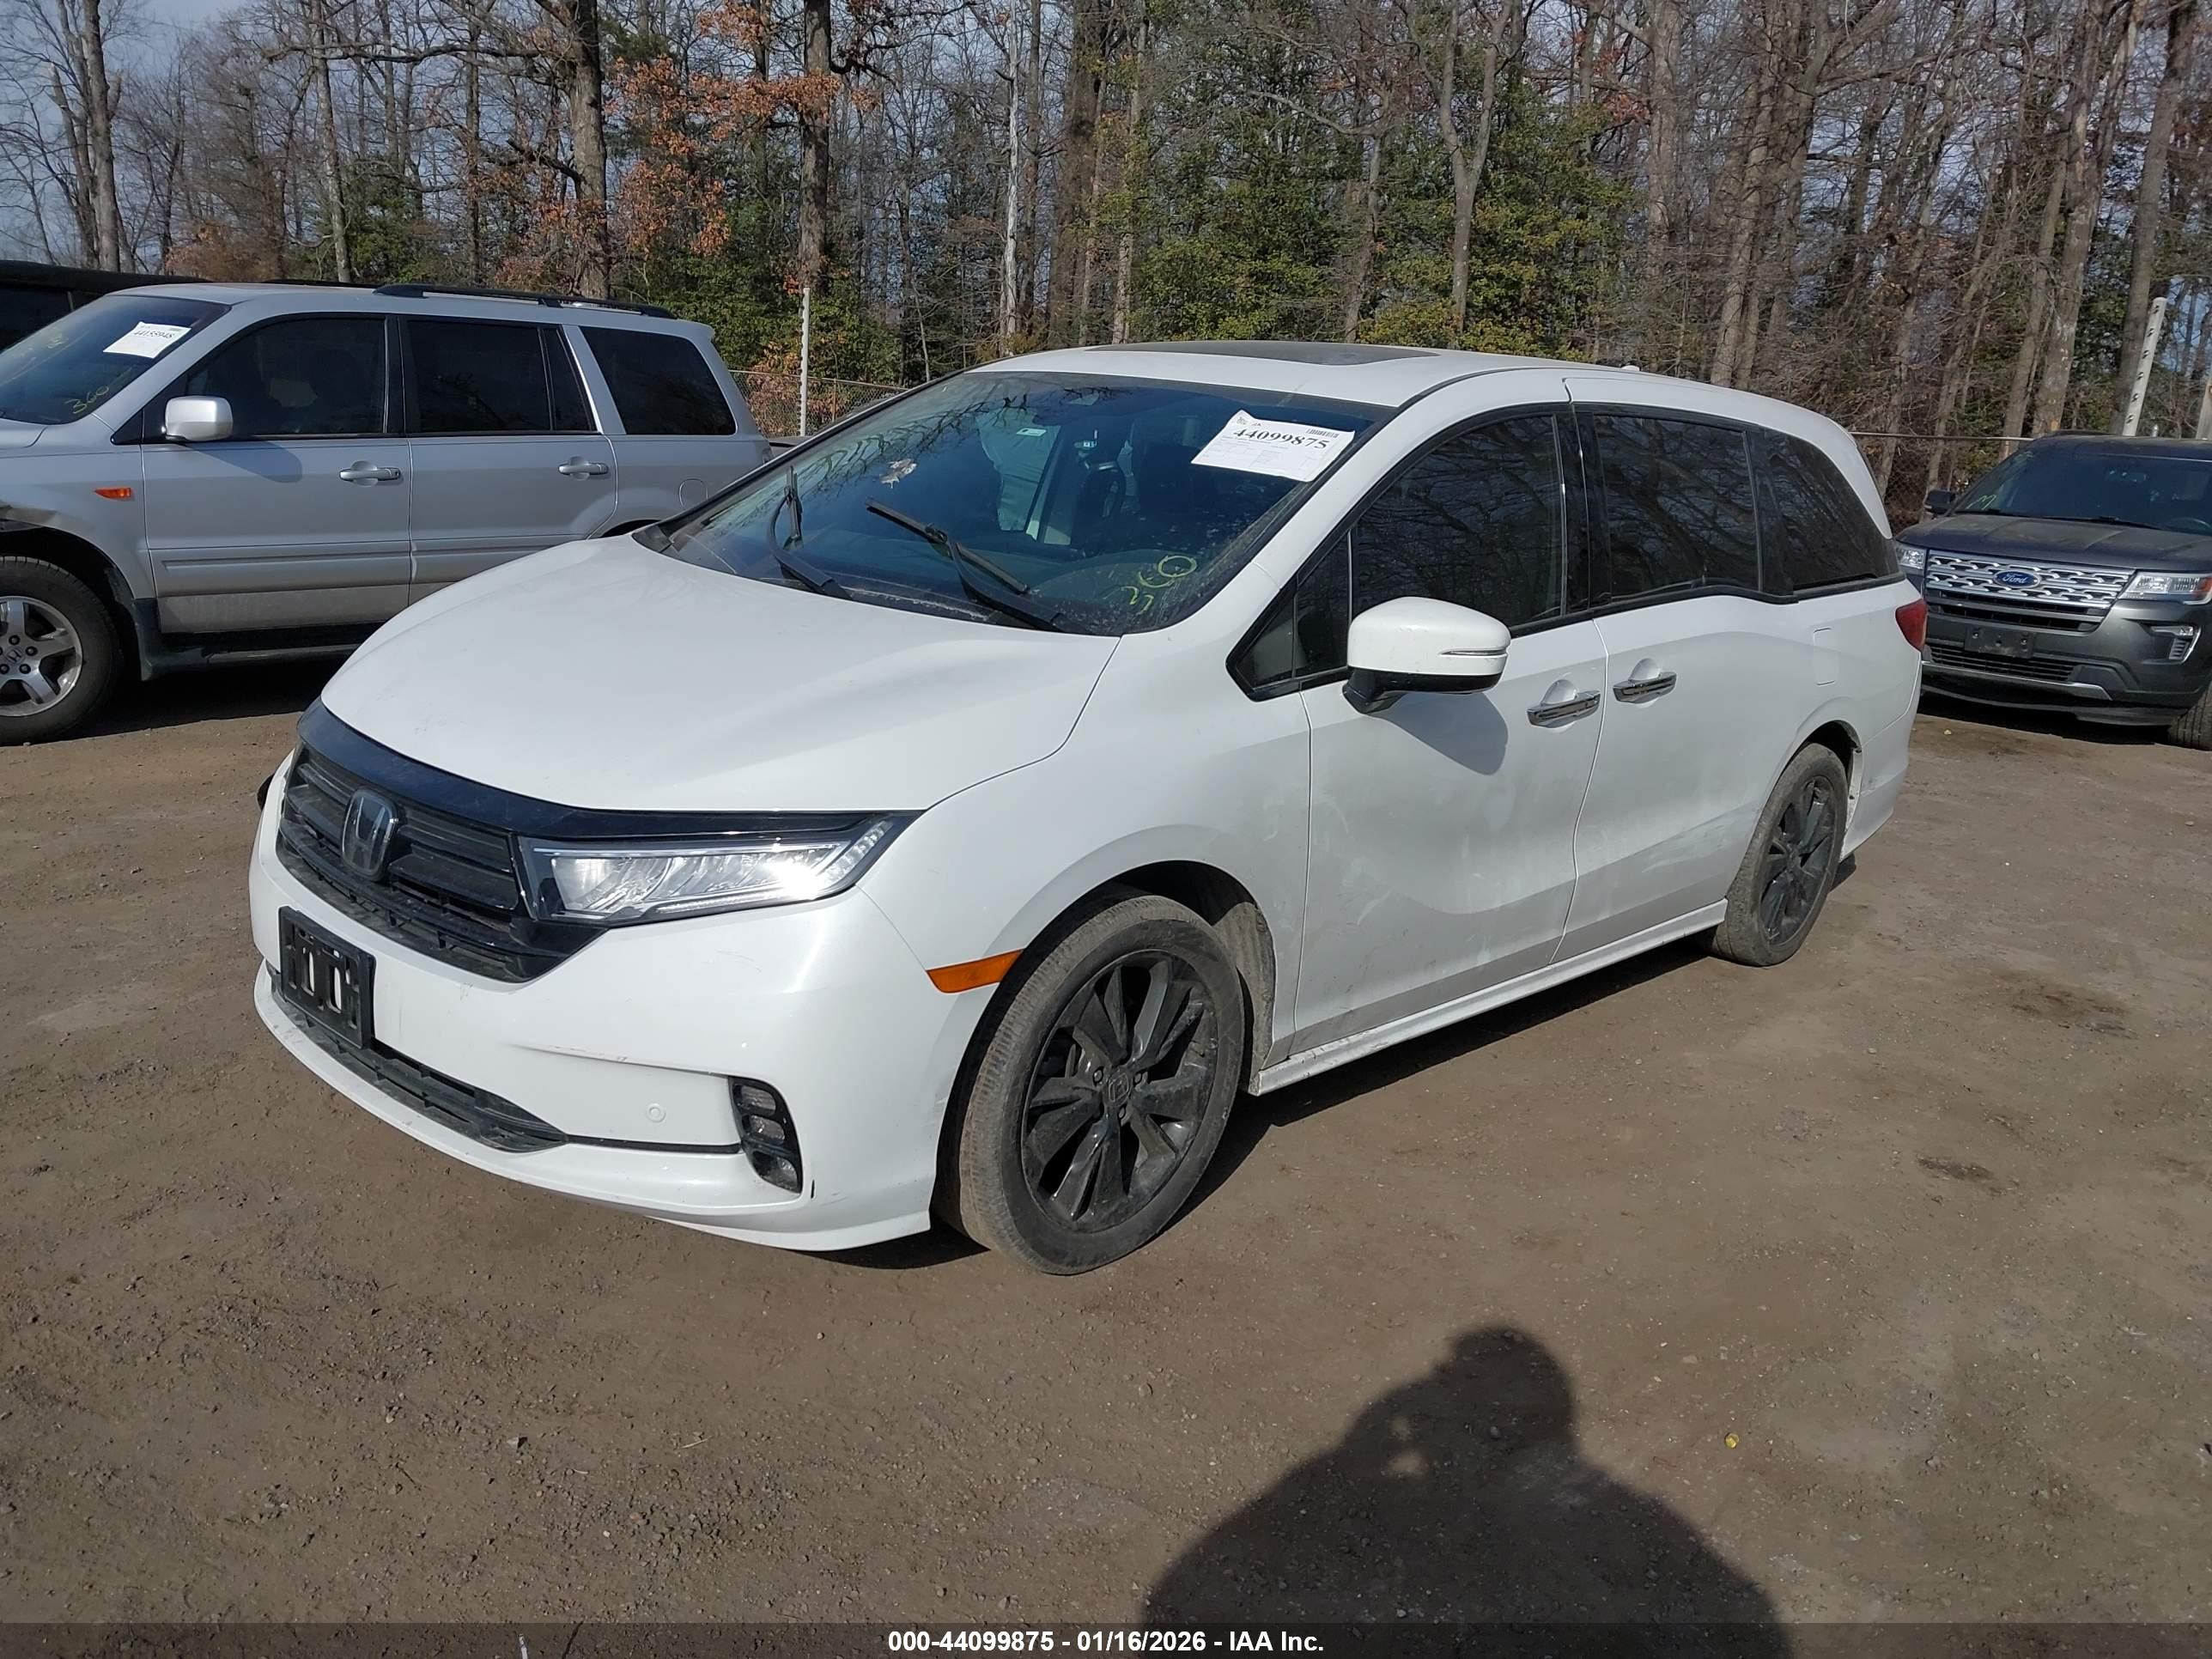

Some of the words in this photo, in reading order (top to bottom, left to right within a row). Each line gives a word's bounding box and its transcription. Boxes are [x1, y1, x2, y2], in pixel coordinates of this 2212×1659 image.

[64, 386, 110, 414] 360
[1233, 428, 1331, 450] 44099875
[2002, 573, 2028, 584] Ford
